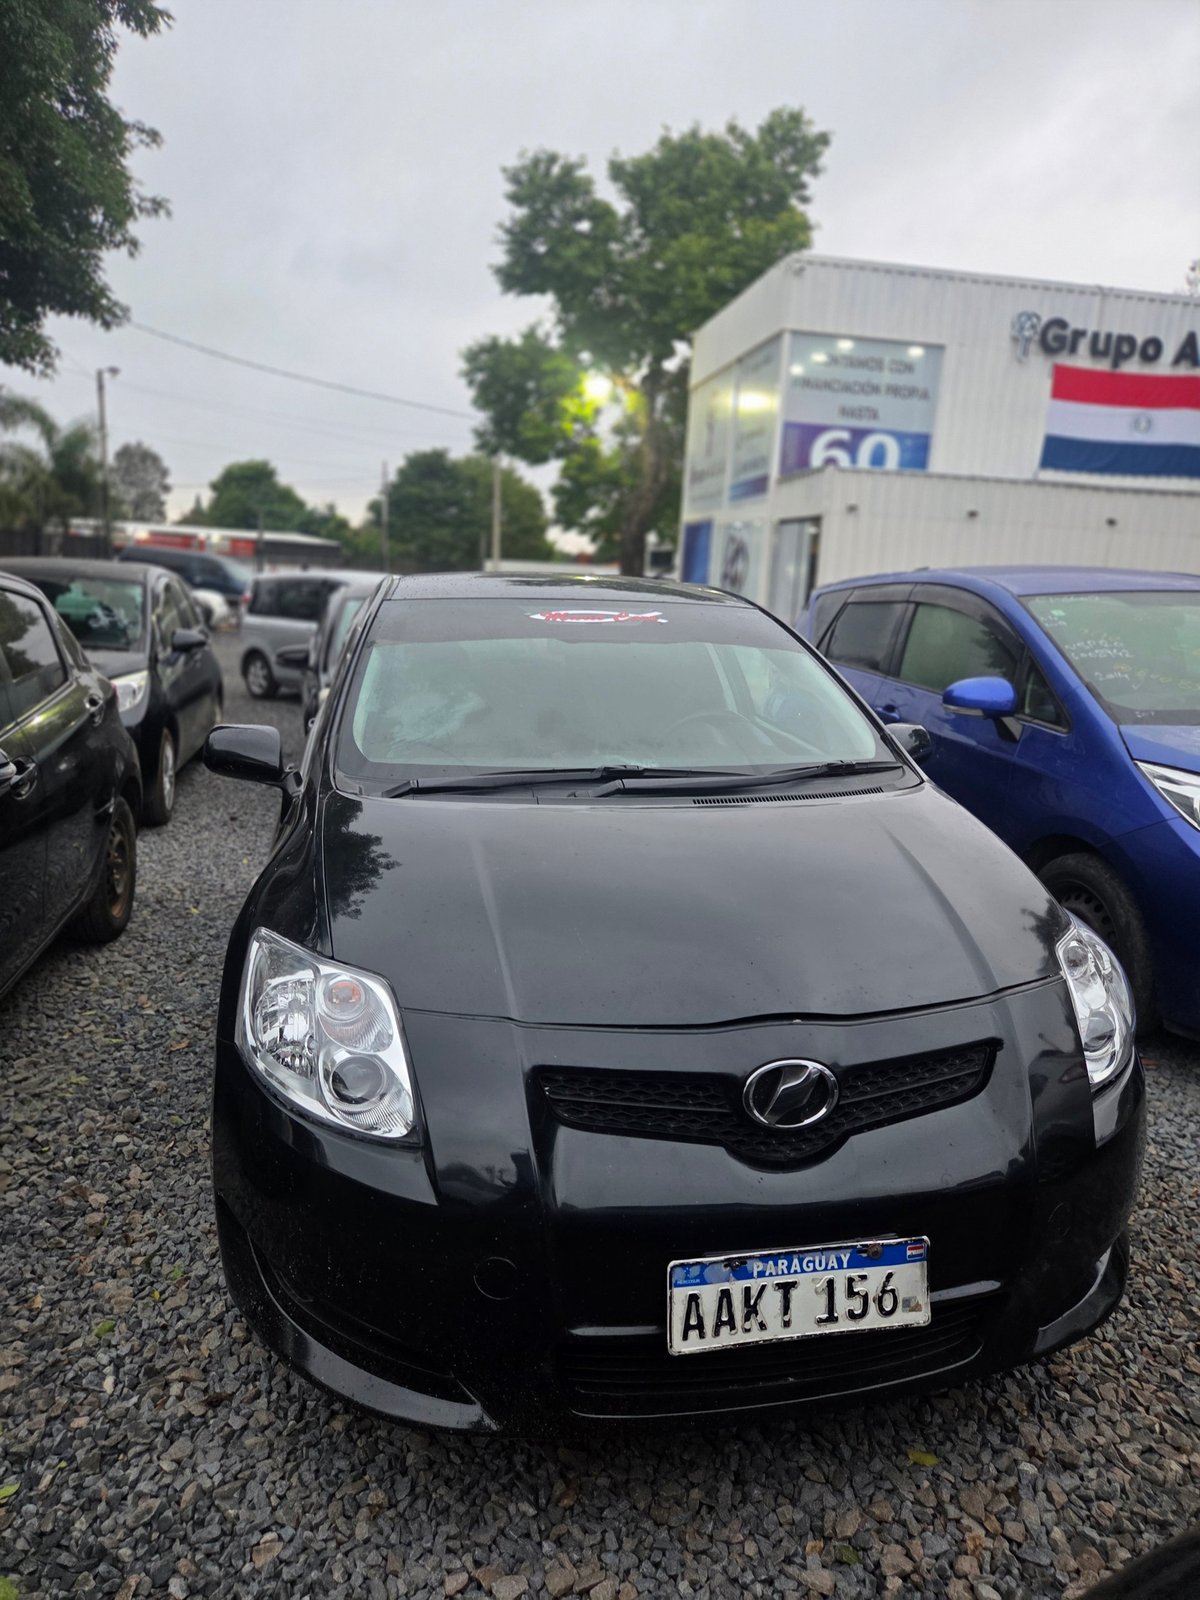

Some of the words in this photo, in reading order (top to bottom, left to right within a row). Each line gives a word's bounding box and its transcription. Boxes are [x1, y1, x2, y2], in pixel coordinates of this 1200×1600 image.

[1039, 317, 1163, 369] Grupo
[810, 429, 900, 470] 60
[753, 1253, 850, 1277] PARAGUAY
[682, 1280, 798, 1341] AAKT
[814, 1271, 899, 1325] 156
